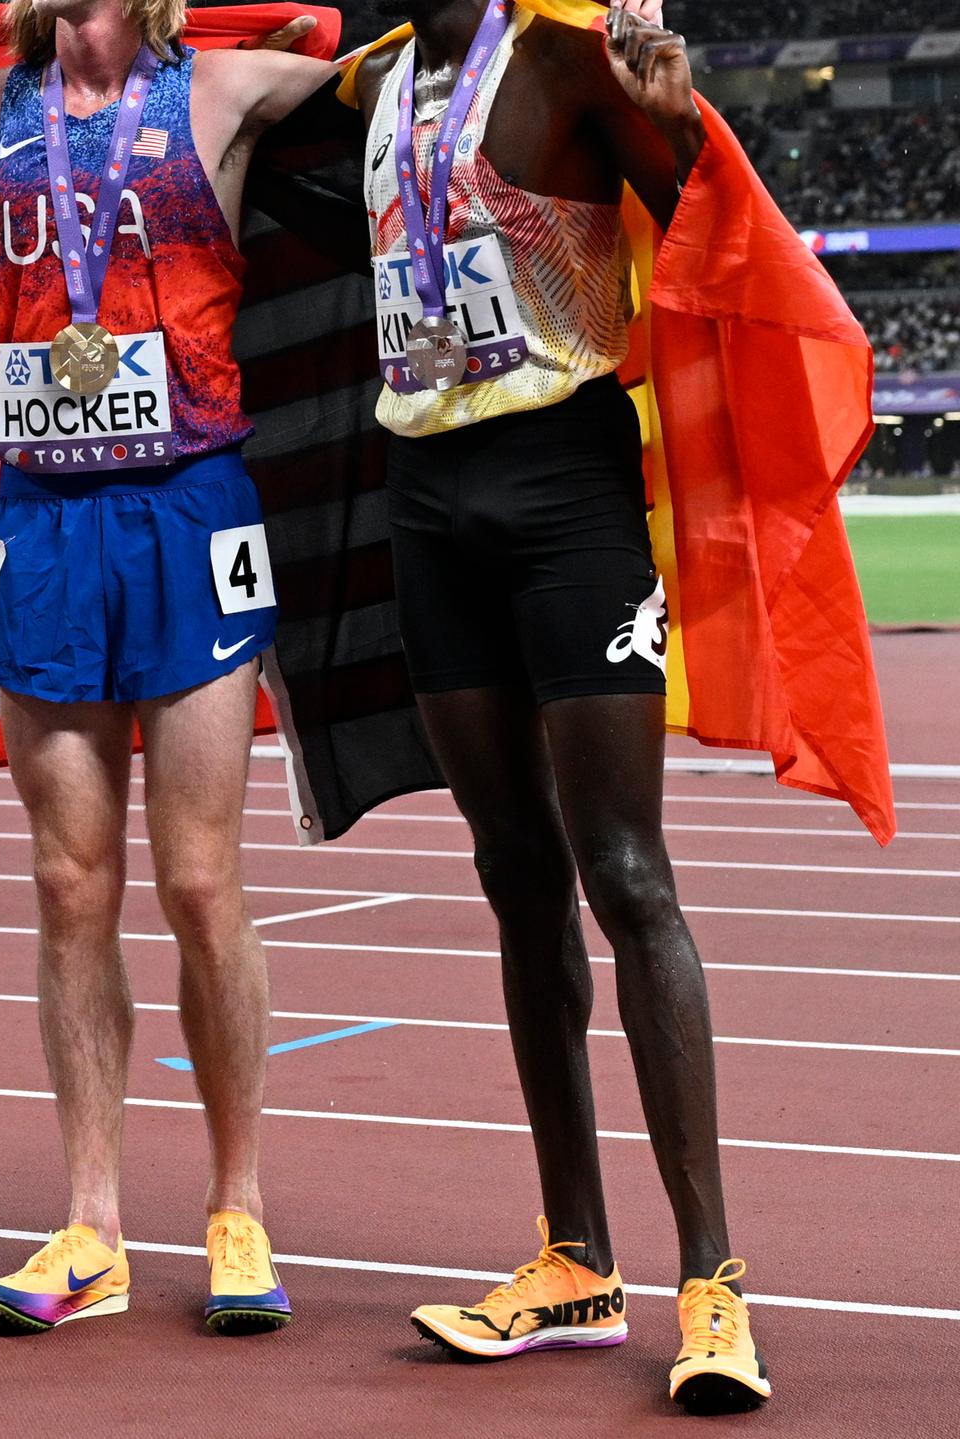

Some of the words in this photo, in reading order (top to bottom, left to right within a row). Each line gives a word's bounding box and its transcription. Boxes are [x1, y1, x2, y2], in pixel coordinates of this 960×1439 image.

[28, 340, 152, 385] TK
[4, 390, 160, 438] HOCKER
[229, 541, 258, 598] 4
[525, 1287, 624, 1328] NITRO
